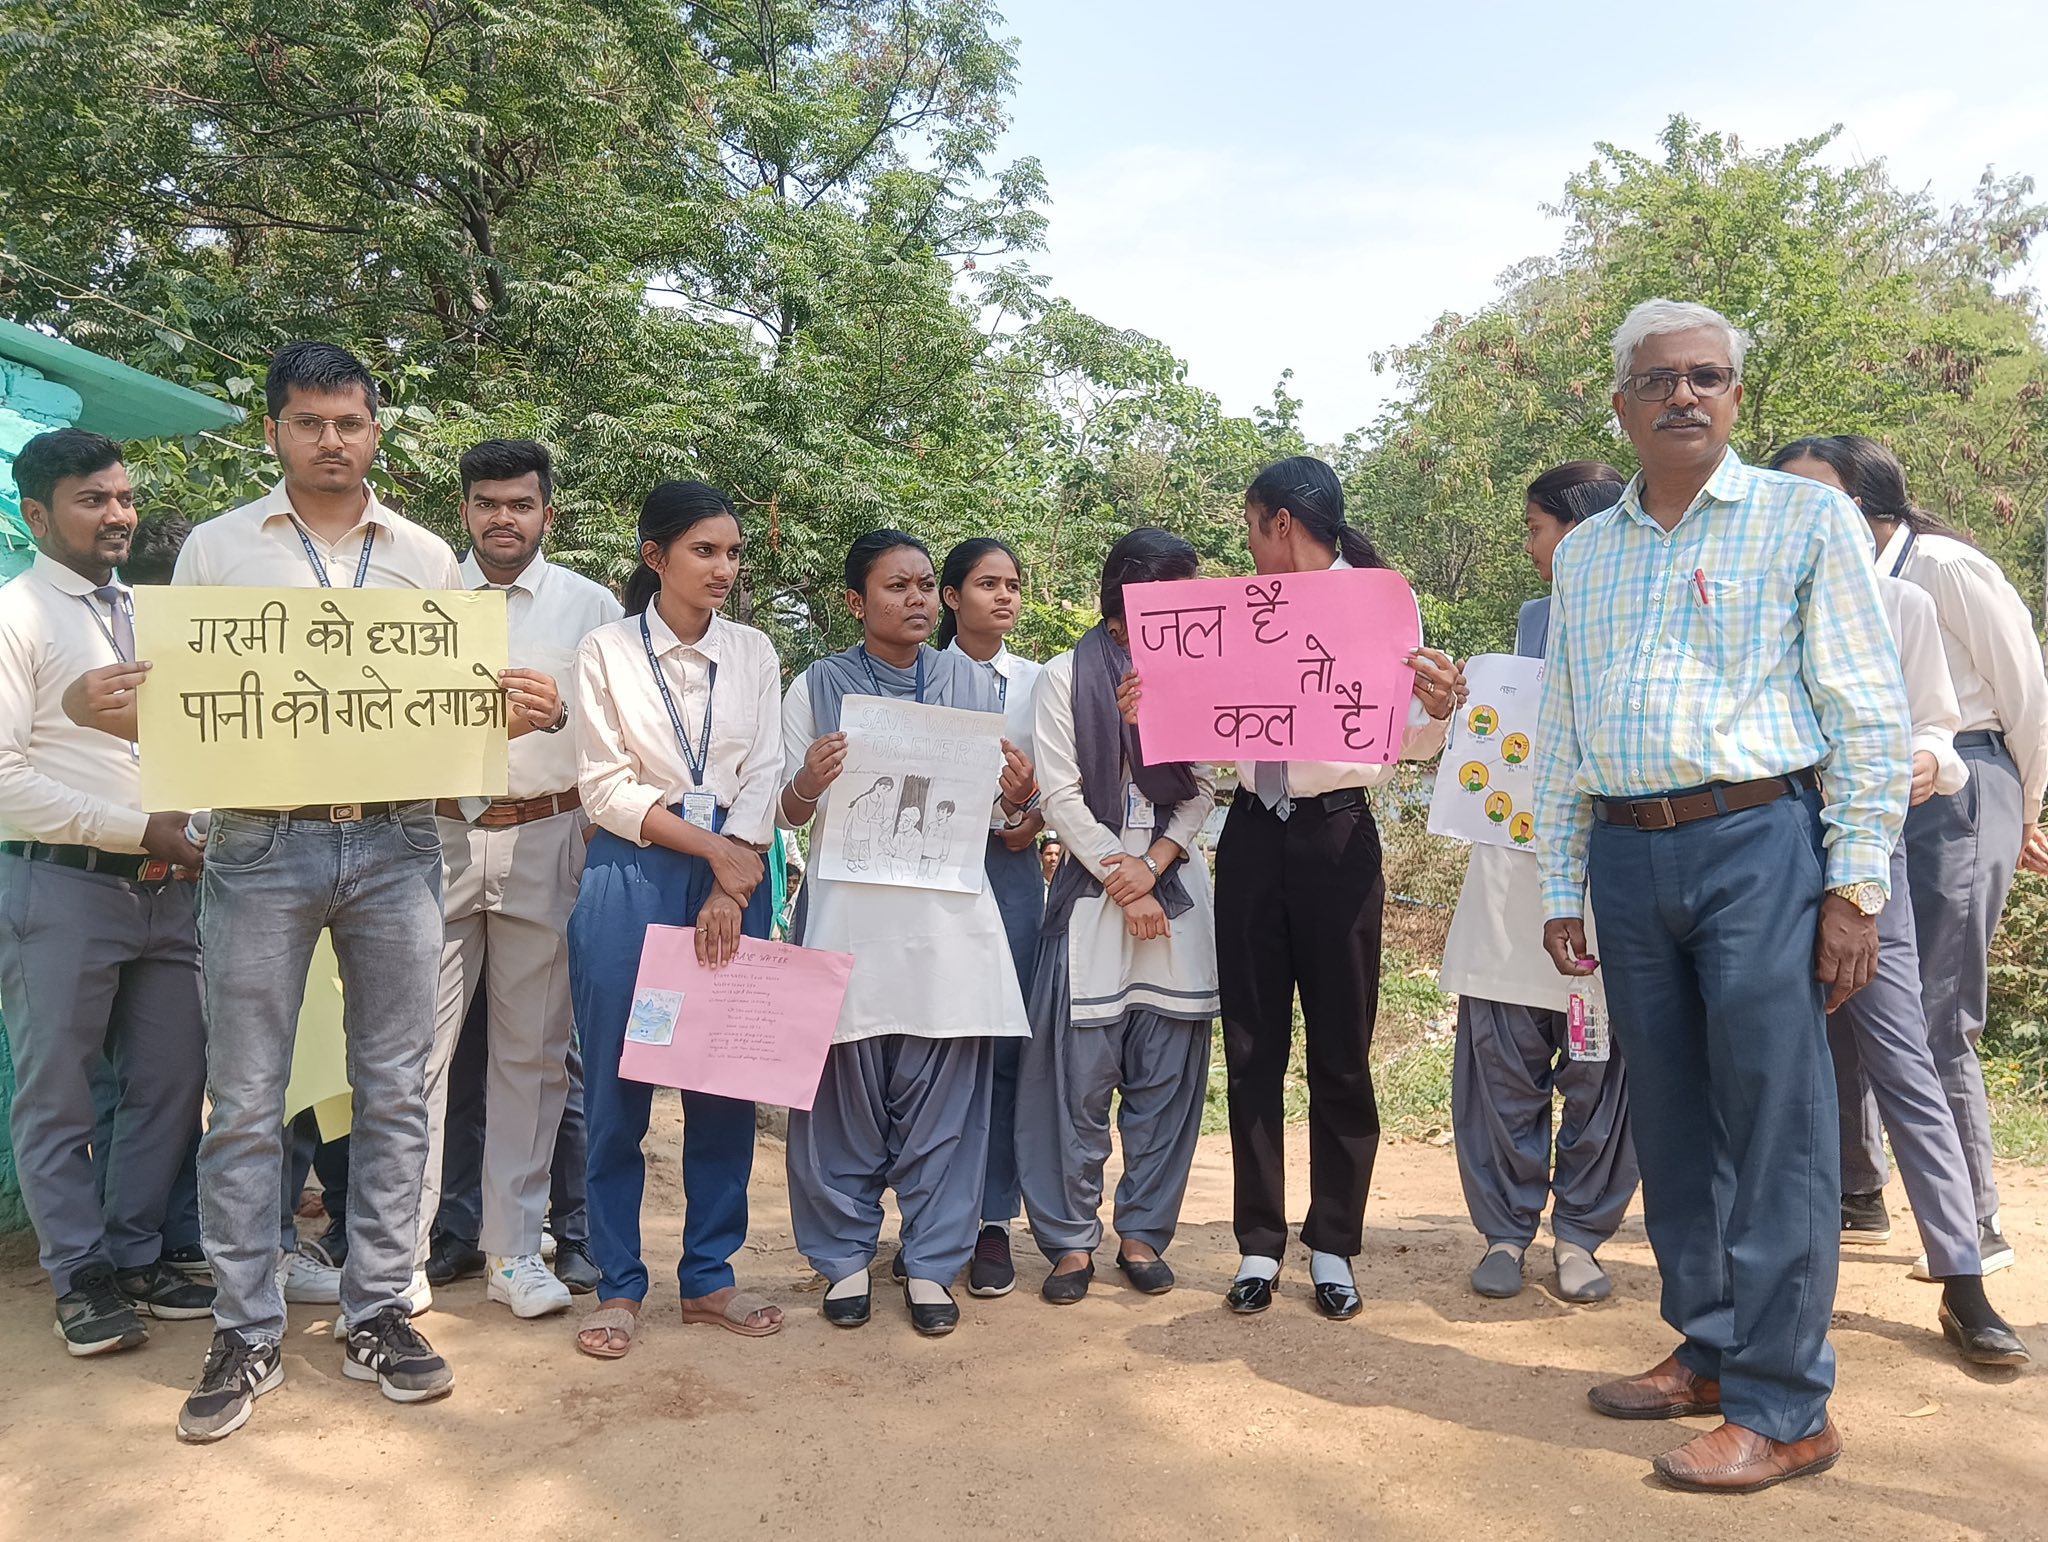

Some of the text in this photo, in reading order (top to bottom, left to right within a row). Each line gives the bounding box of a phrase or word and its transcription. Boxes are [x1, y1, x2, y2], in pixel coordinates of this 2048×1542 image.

[188, 601, 289, 656] गरमी
[306, 600, 353, 656] को
[366, 600, 458, 659] हराओ
[1140, 580, 1289, 659] जल है
[1297, 634, 1336, 694] तो
[180, 662, 508, 742] पानी को गले लगाओ
[859, 705, 1003, 737] SAVE WATER
[1213, 705, 1297, 748] कल
